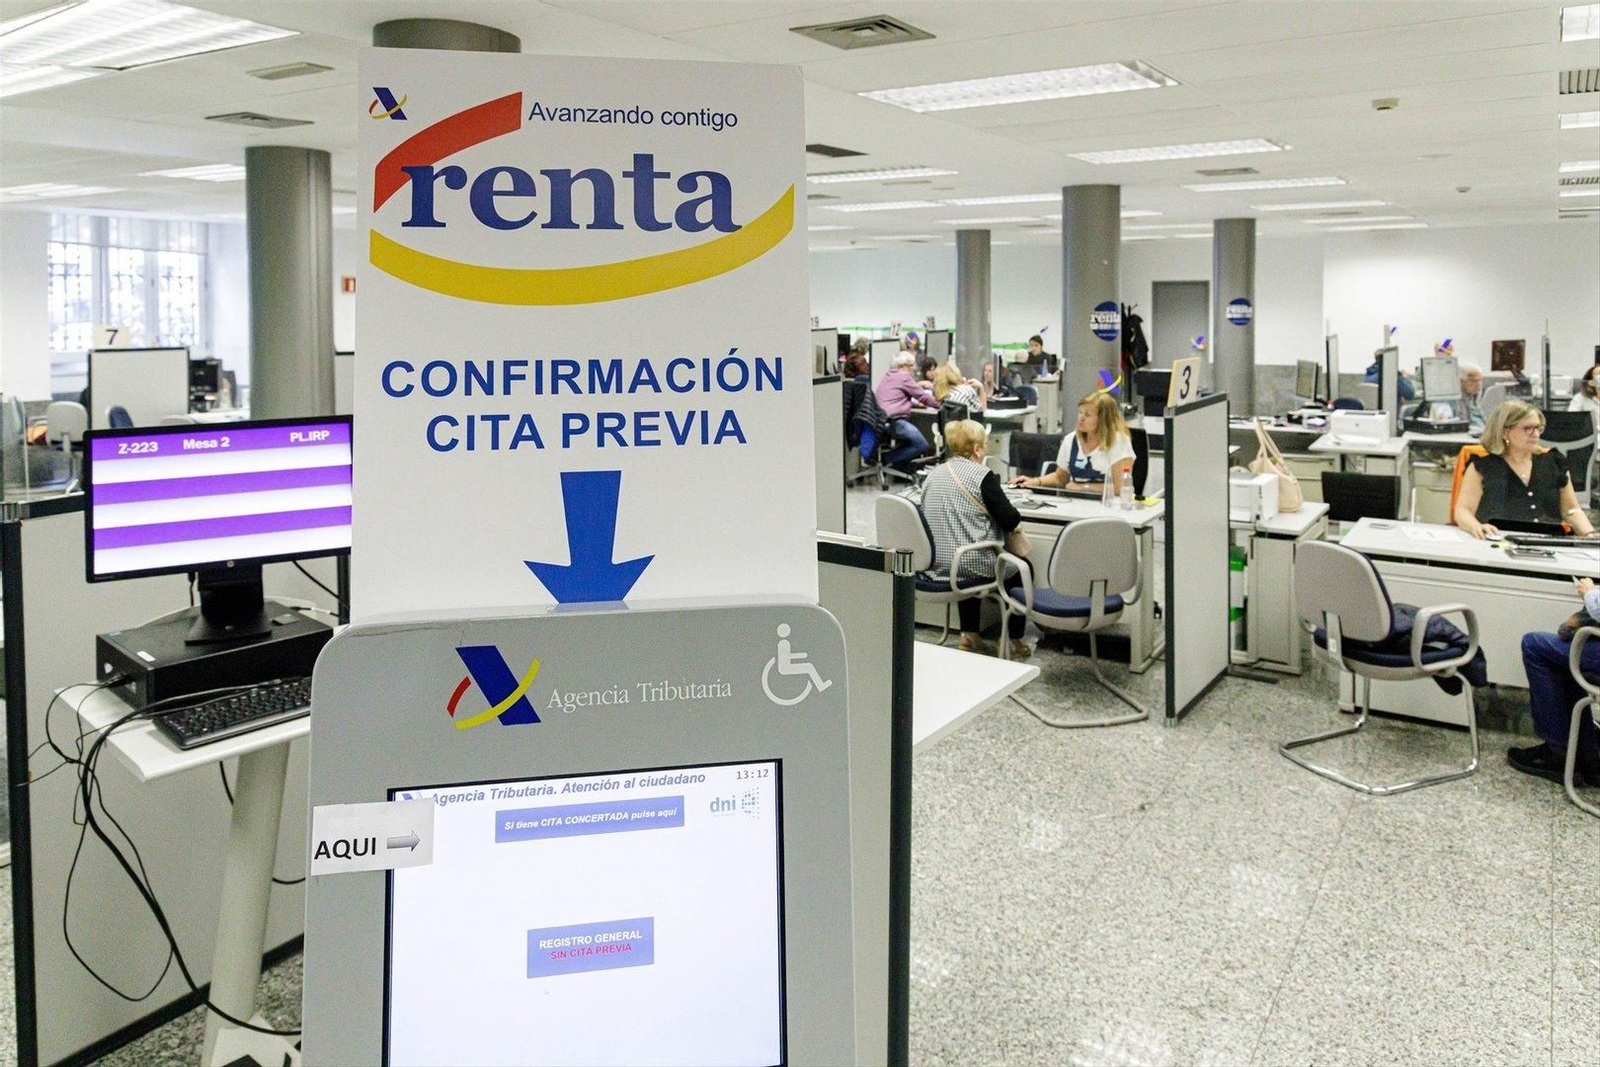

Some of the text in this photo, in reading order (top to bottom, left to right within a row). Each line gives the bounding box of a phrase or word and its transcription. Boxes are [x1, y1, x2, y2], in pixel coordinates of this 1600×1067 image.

[528, 102, 738, 132] Avanzando contigo
[401, 153, 742, 234] renta
[105, 328, 119, 346] 7
[381, 347, 783, 398] CONFIRMACIÓN
[1180, 364, 1192, 400] 3
[425, 408, 748, 453] CITA PREVIA
[118, 440, 159, 455] Z-223
[183, 438, 218, 450] Mesa
[220, 436, 231, 448] 2
[547, 678, 732, 714] Agencia Tributaria
[736, 768, 769, 780] 13:12
[432, 773, 706, 807] Agencia Tributaria. Atención al ciudadano
[710, 794, 737, 813] dni
[516, 820, 539, 830] tiene
[541, 817, 563, 828] CITA
[565, 811, 629, 826] CONCERTADA
[630, 809, 656, 821] pulse
[313, 837, 377, 860] AQUI
[539, 929, 643, 950] REGISTRO GENERAL
[550, 943, 633, 961] SIN CITA PREVIA
